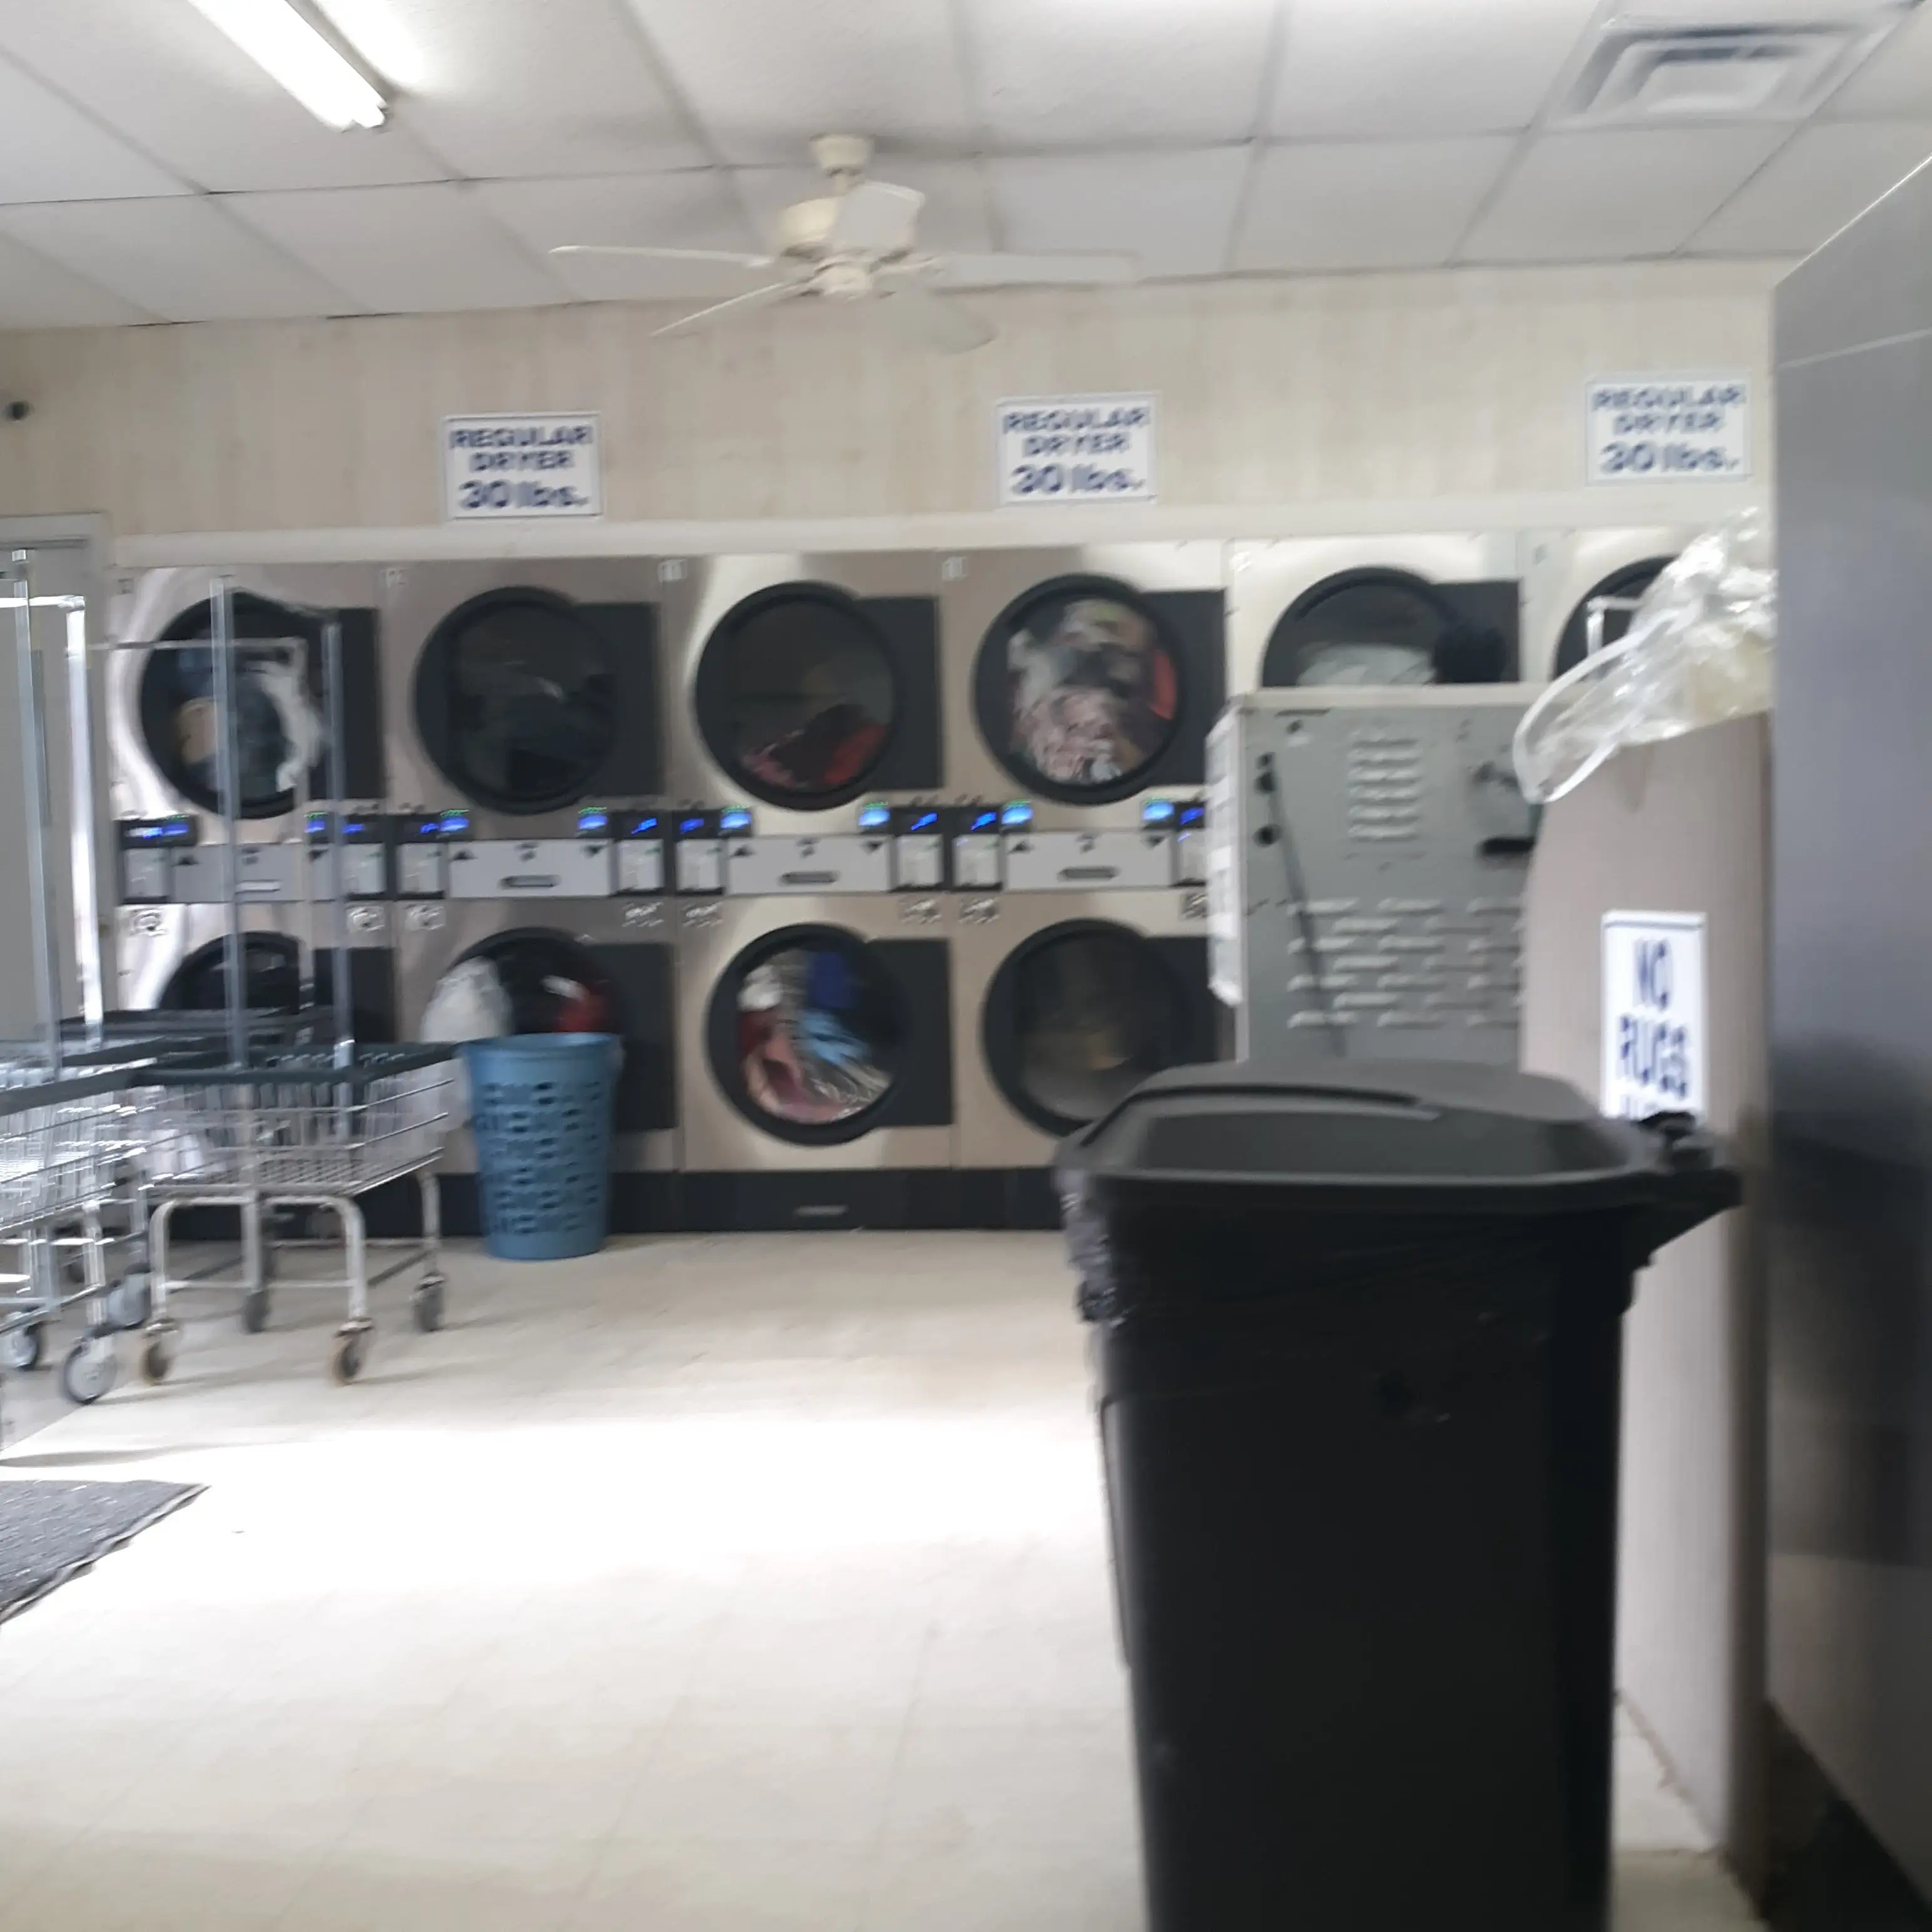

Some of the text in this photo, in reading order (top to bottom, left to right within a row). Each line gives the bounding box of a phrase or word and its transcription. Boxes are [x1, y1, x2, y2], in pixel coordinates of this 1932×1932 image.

[1592, 385, 1746, 410] REGULAR
[1003, 407, 1150, 433] REGULAR
[1614, 410, 1726, 434] DRYER
[449, 427, 592, 448] REGULAR
[1022, 432, 1130, 457] DRYER
[469, 452, 576, 470] DRYER
